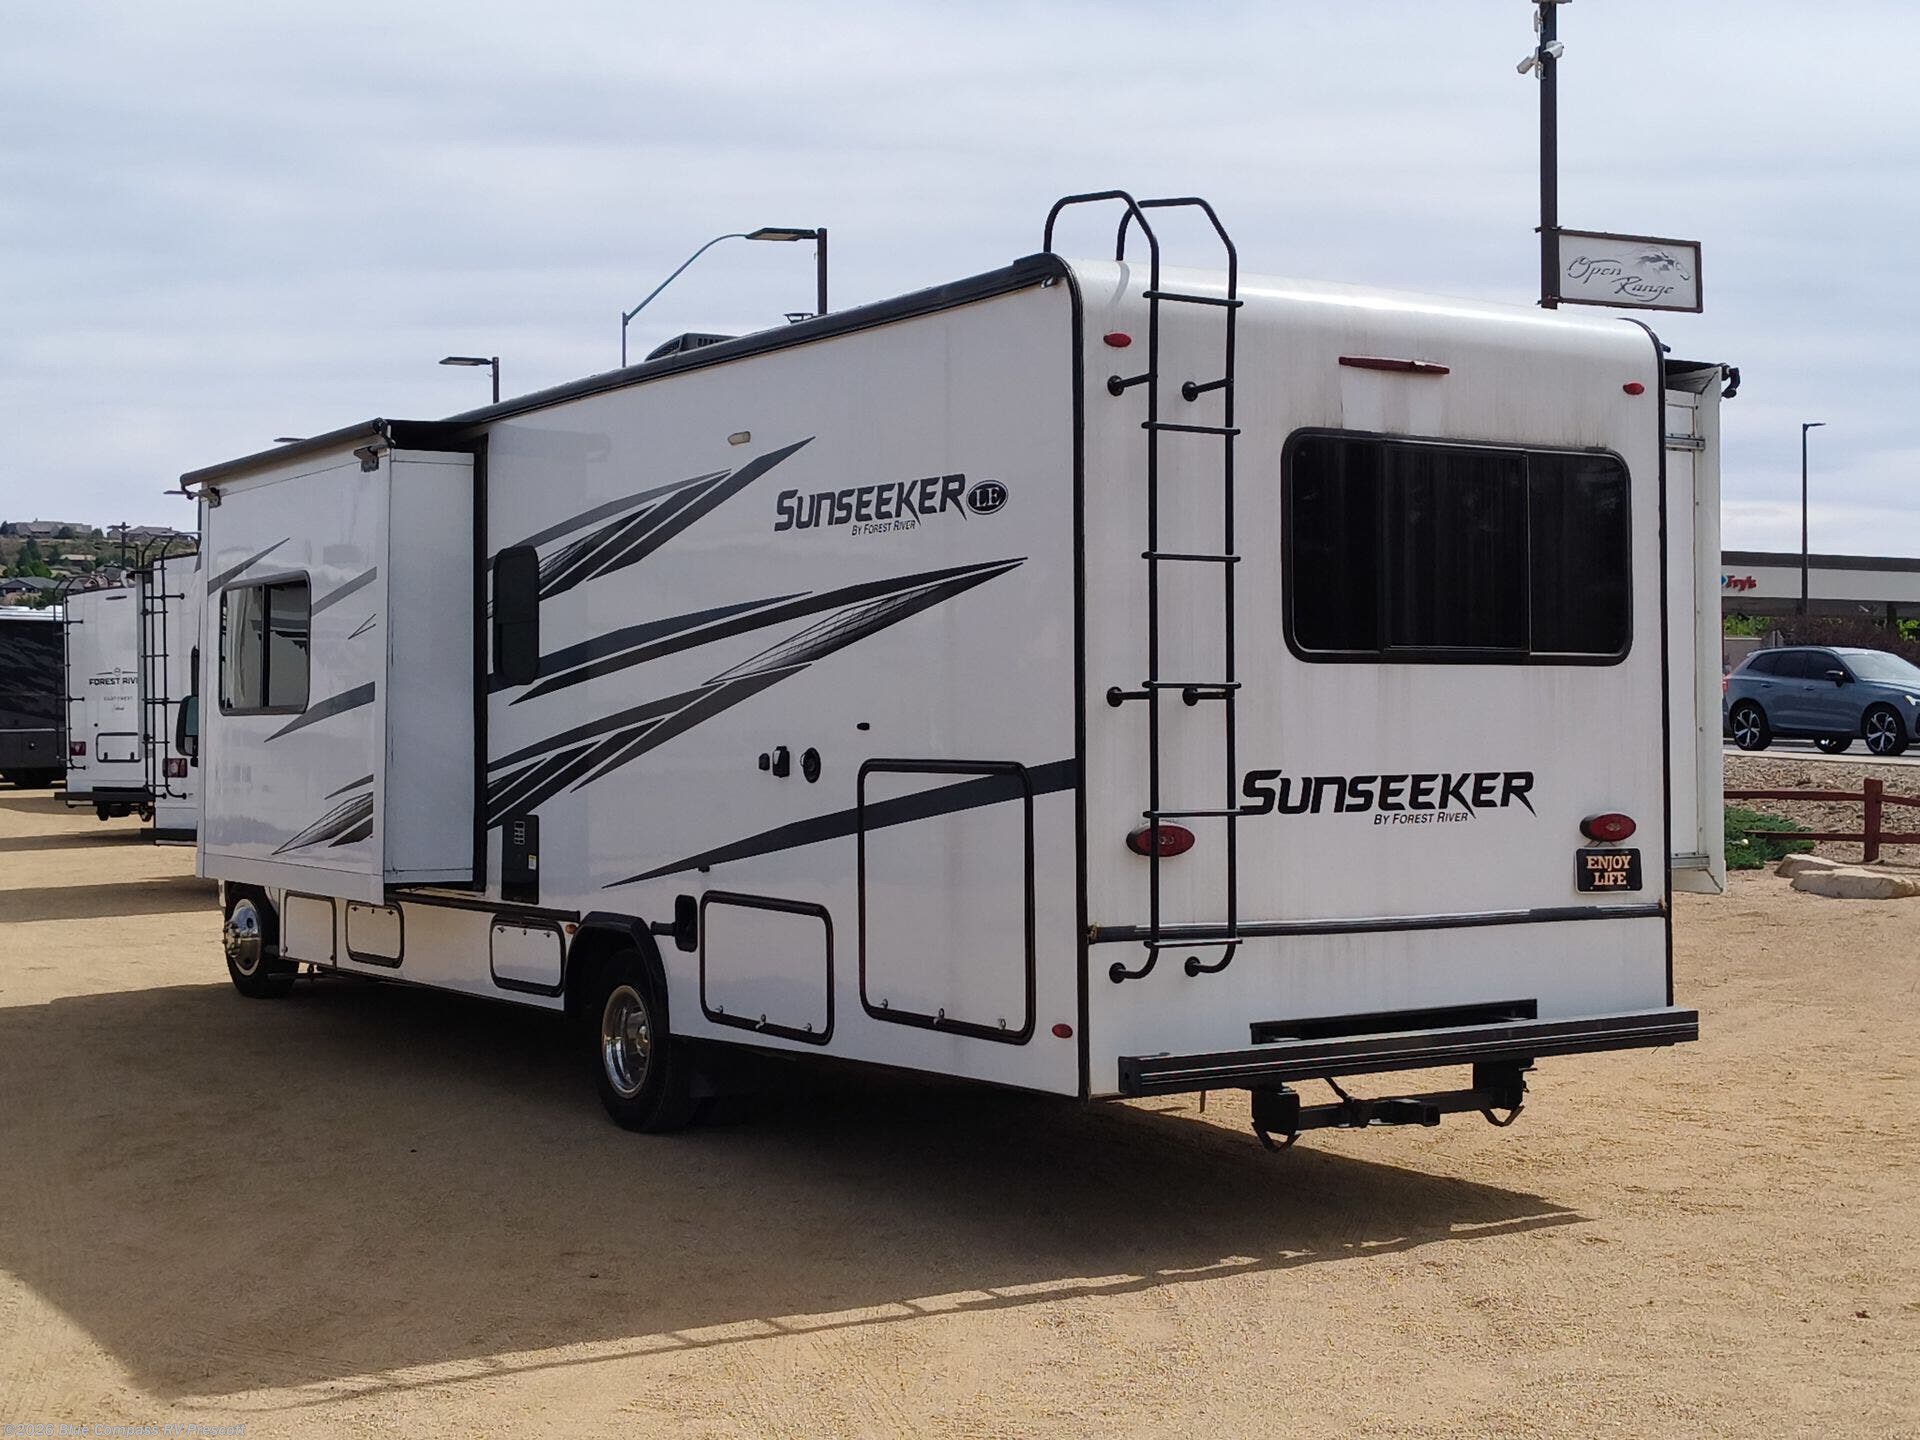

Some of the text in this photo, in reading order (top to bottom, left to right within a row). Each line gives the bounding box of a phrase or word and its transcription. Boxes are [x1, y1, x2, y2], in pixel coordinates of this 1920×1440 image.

[1568, 256, 1623, 284] Open
[1611, 276, 1674, 302] Range
[774, 473, 1000, 532] SUNSEEKER LE
[851, 520, 916, 536] BY FOREST RIVER
[89, 677, 139, 686] FOREST RIV
[1240, 769, 1538, 818] SUNSEEKER
[1373, 811, 1469, 825] BY FOREST RIVER
[1586, 855, 1632, 871] ENJOY
[1593, 871, 1627, 886] LIFE
